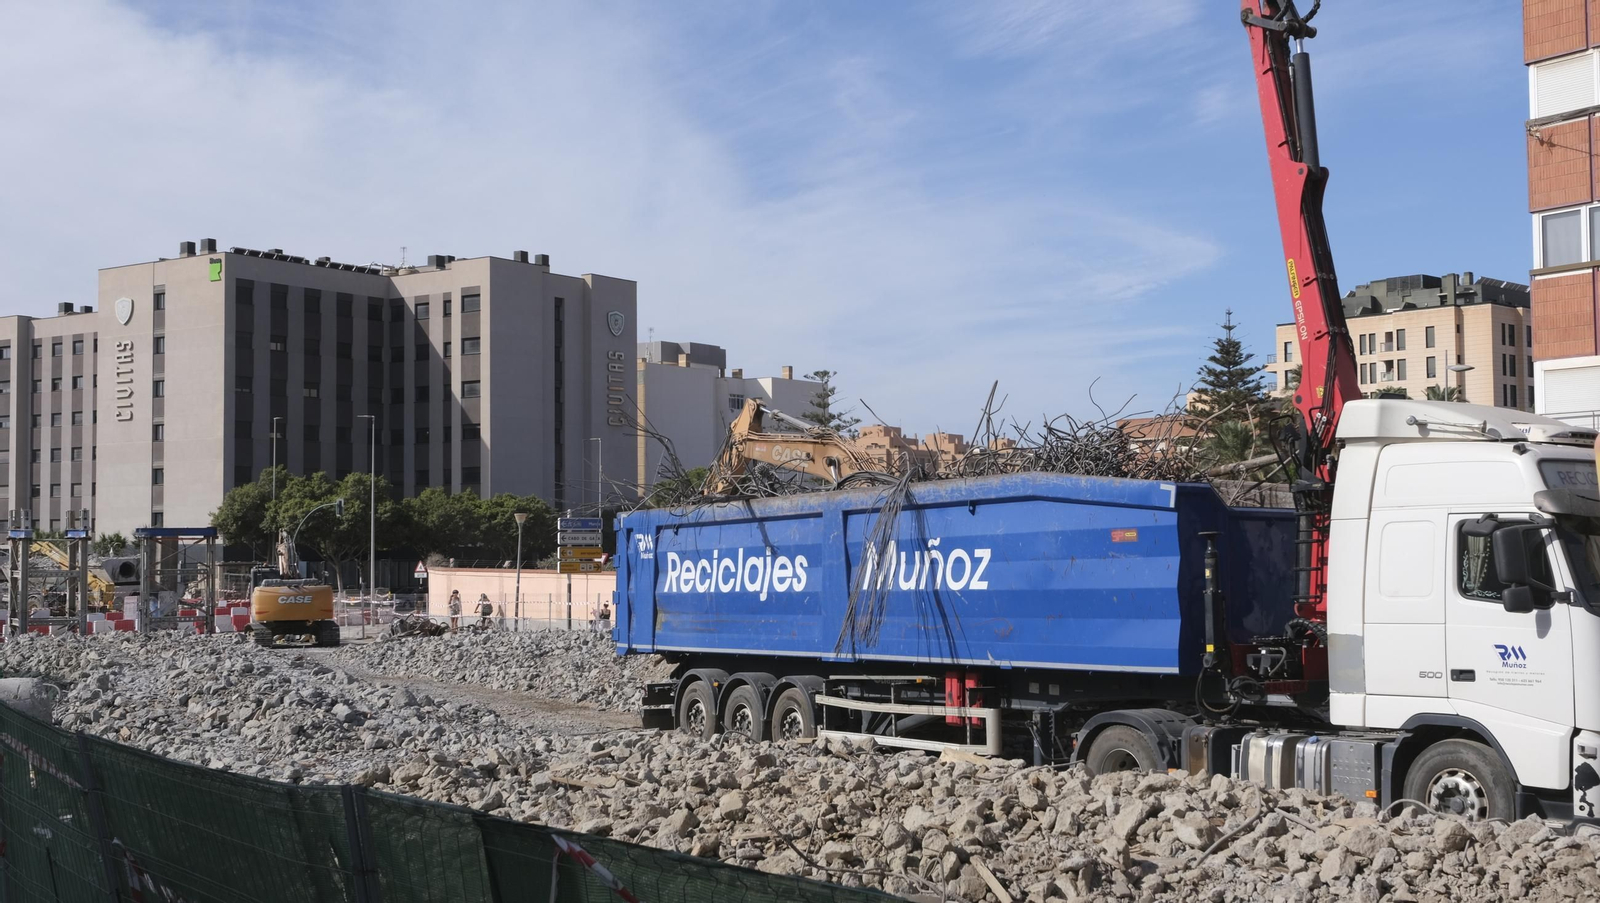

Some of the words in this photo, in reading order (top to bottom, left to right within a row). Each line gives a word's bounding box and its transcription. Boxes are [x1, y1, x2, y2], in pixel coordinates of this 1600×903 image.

[1288, 260, 1299, 297] PALFINGER
[1295, 300, 1308, 340] EPSILON
[115, 340, 134, 422] CIVITAS
[608, 350, 625, 426] CIVITAS
[1557, 471, 1598, 486] RECIC
[664, 547, 808, 602] Reciclajes
[863, 537, 992, 591] Muñoz
[277, 595, 313, 604] CASE
[1419, 671, 1443, 679] 500
[1501, 661, 1527, 669] Muñoz
